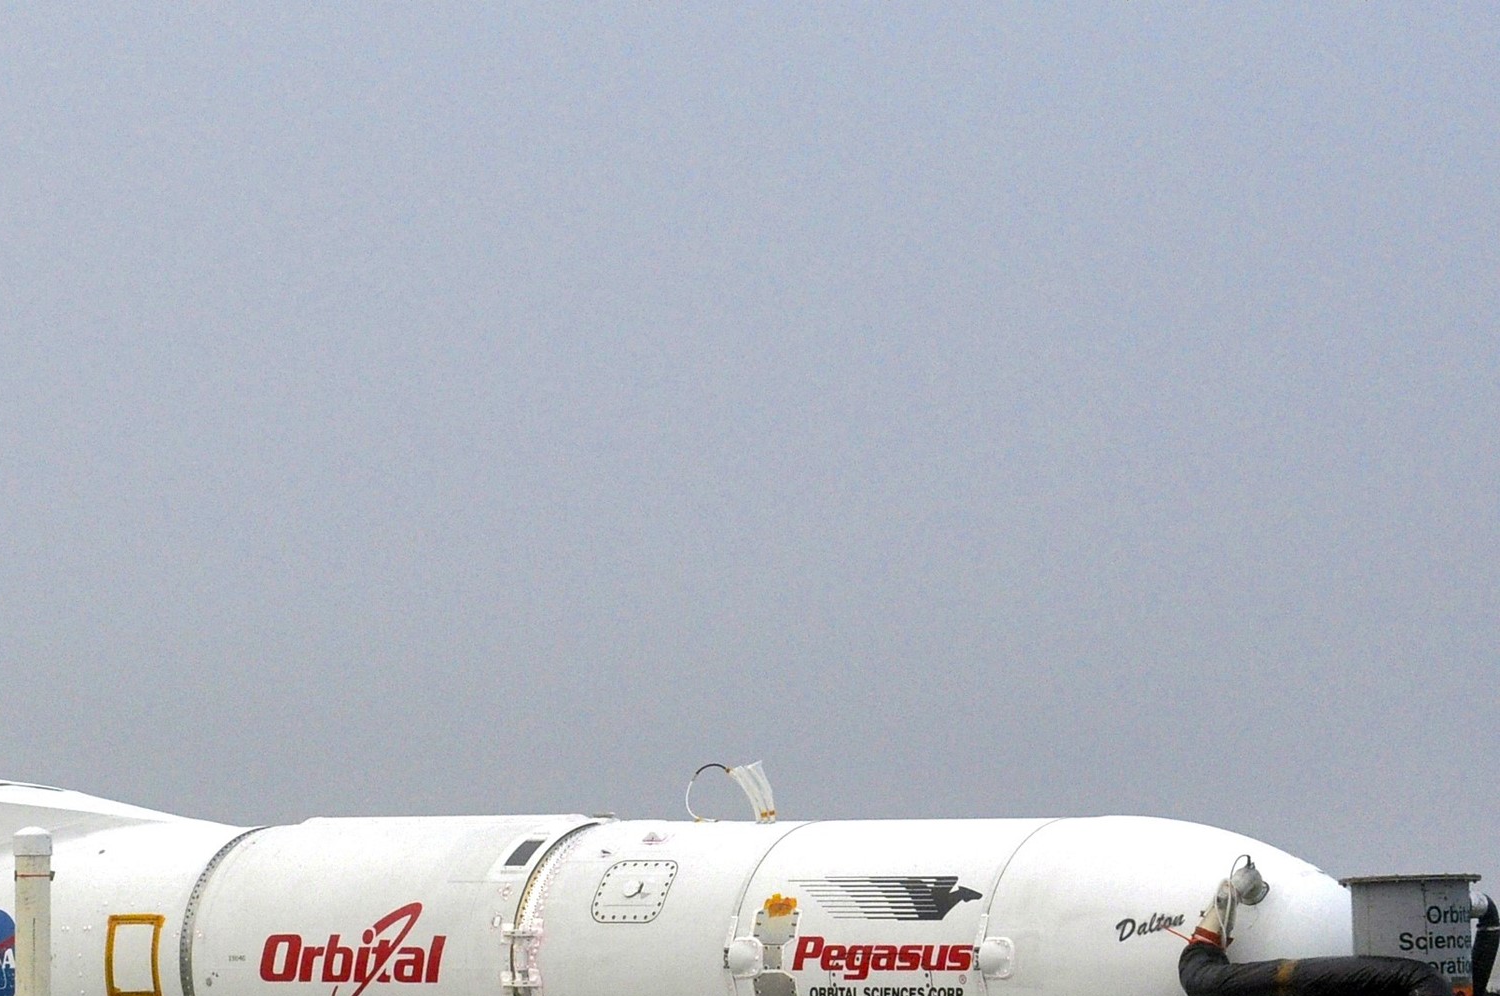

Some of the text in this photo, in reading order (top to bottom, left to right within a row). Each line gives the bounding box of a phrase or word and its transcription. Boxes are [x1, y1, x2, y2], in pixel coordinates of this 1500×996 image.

[1116, 912, 1186, 942] Dalton
[1426, 905, 1470, 924] Orbit
[260, 929, 447, 983] Orbital
[1399, 932, 1472, 950] Science
[792, 936, 974, 980] Pegasus
